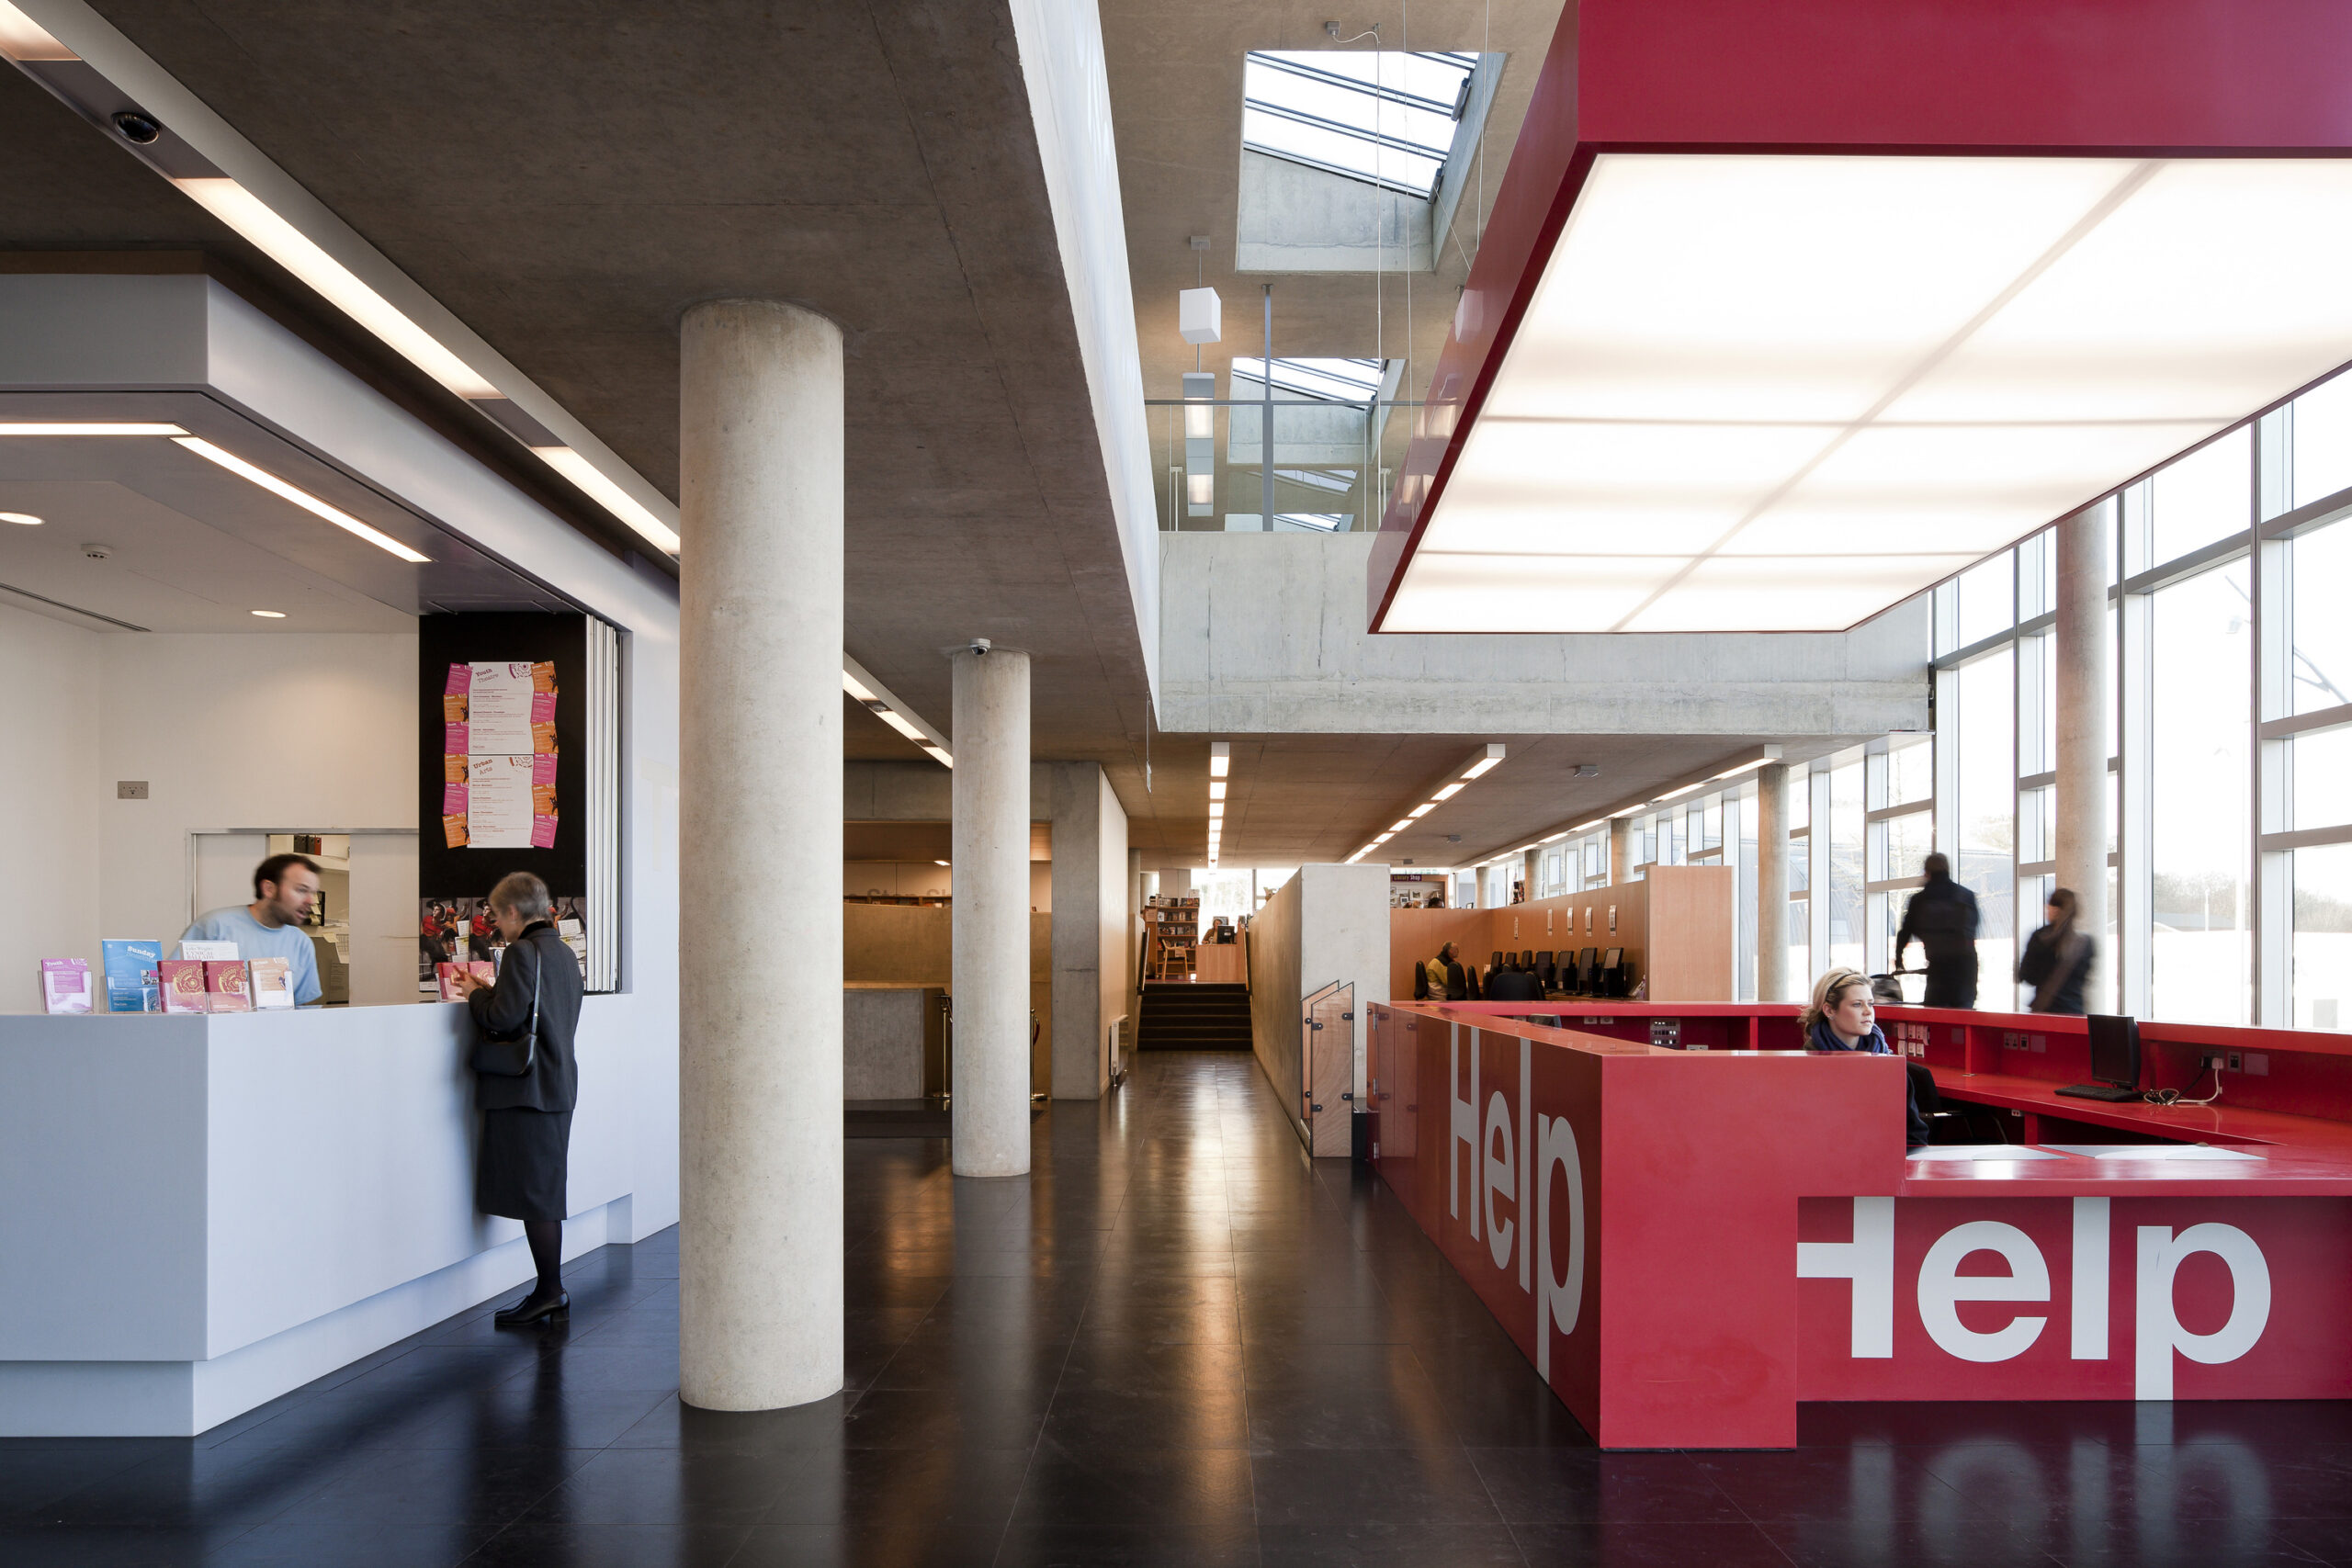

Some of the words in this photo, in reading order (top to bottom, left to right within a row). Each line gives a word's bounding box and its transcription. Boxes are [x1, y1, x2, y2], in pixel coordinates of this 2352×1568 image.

[475, 668, 493, 677] Youth
[472, 759, 493, 769] Urban
[127, 945, 156, 959] Sunday
[1451, 1021, 1585, 1385] Help
[1796, 1196, 2271, 1401] Help
